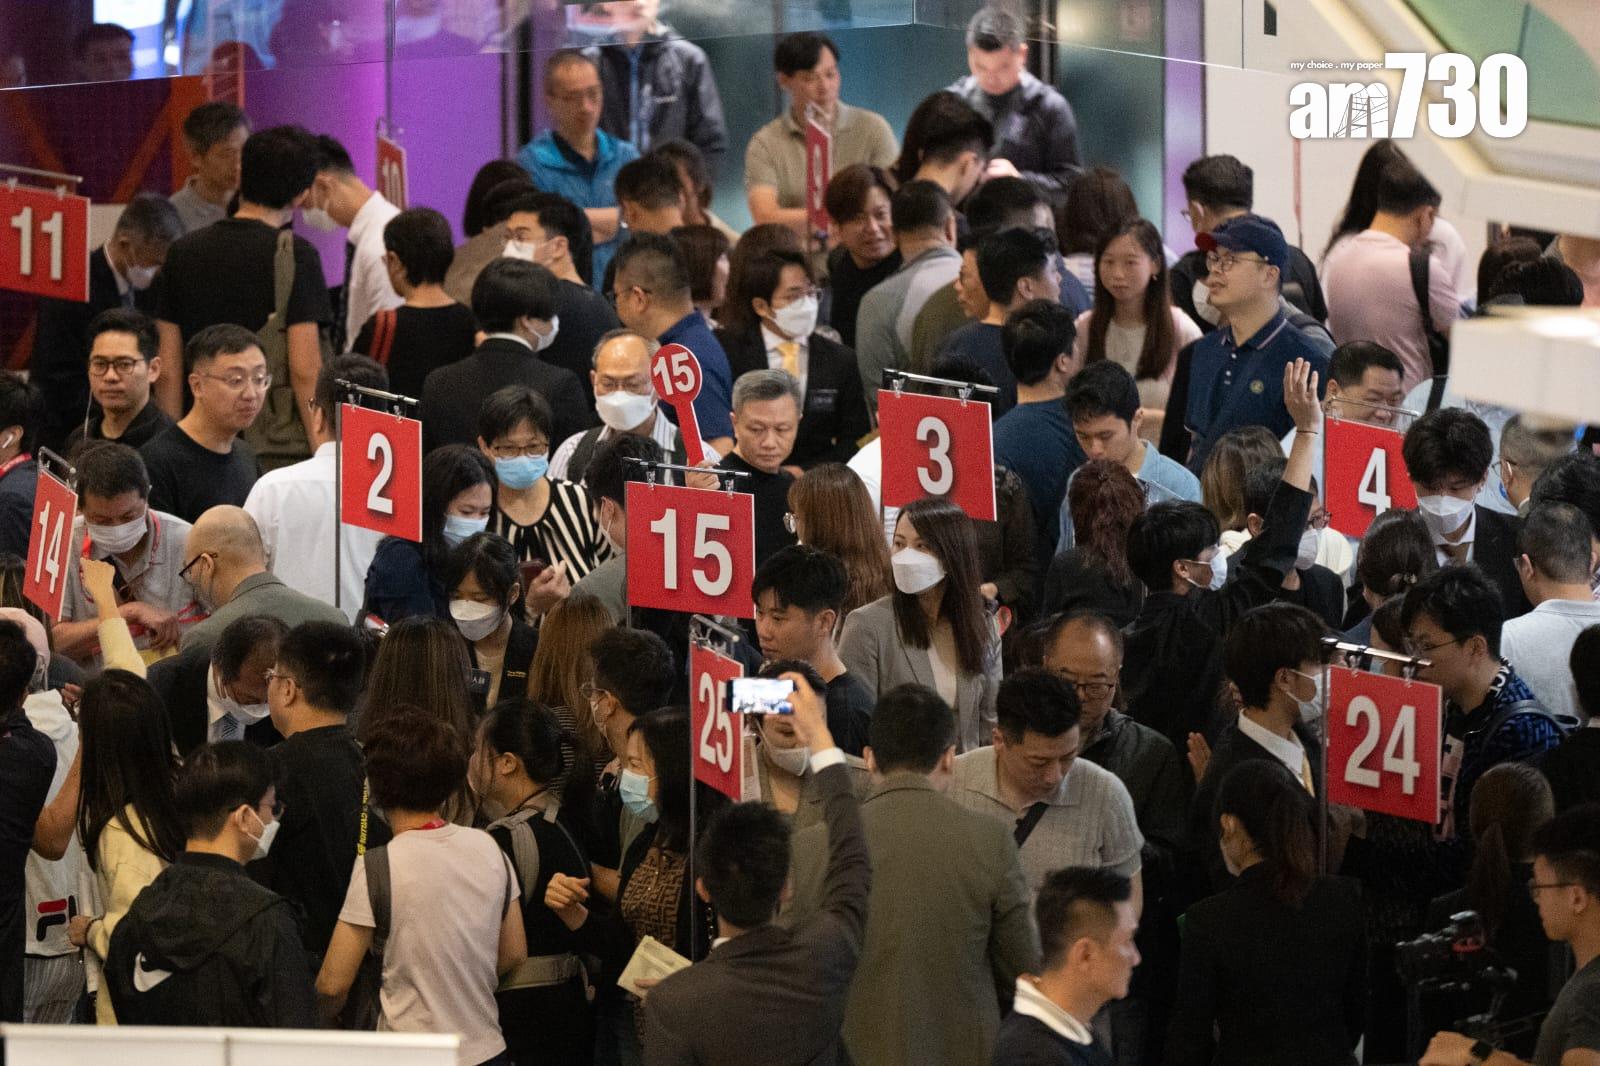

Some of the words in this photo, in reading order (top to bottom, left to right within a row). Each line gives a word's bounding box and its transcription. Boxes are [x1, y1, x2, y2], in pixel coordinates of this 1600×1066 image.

[11, 206, 63, 280] 11
[652, 352, 696, 396] 15
[366, 432, 393, 515] 2
[916, 416, 954, 495] 3
[1358, 447, 1391, 516] 4
[34, 500, 65, 594] 14
[650, 508, 733, 597] 15
[699, 671, 734, 773] 25
[1344, 695, 1421, 795] 24
